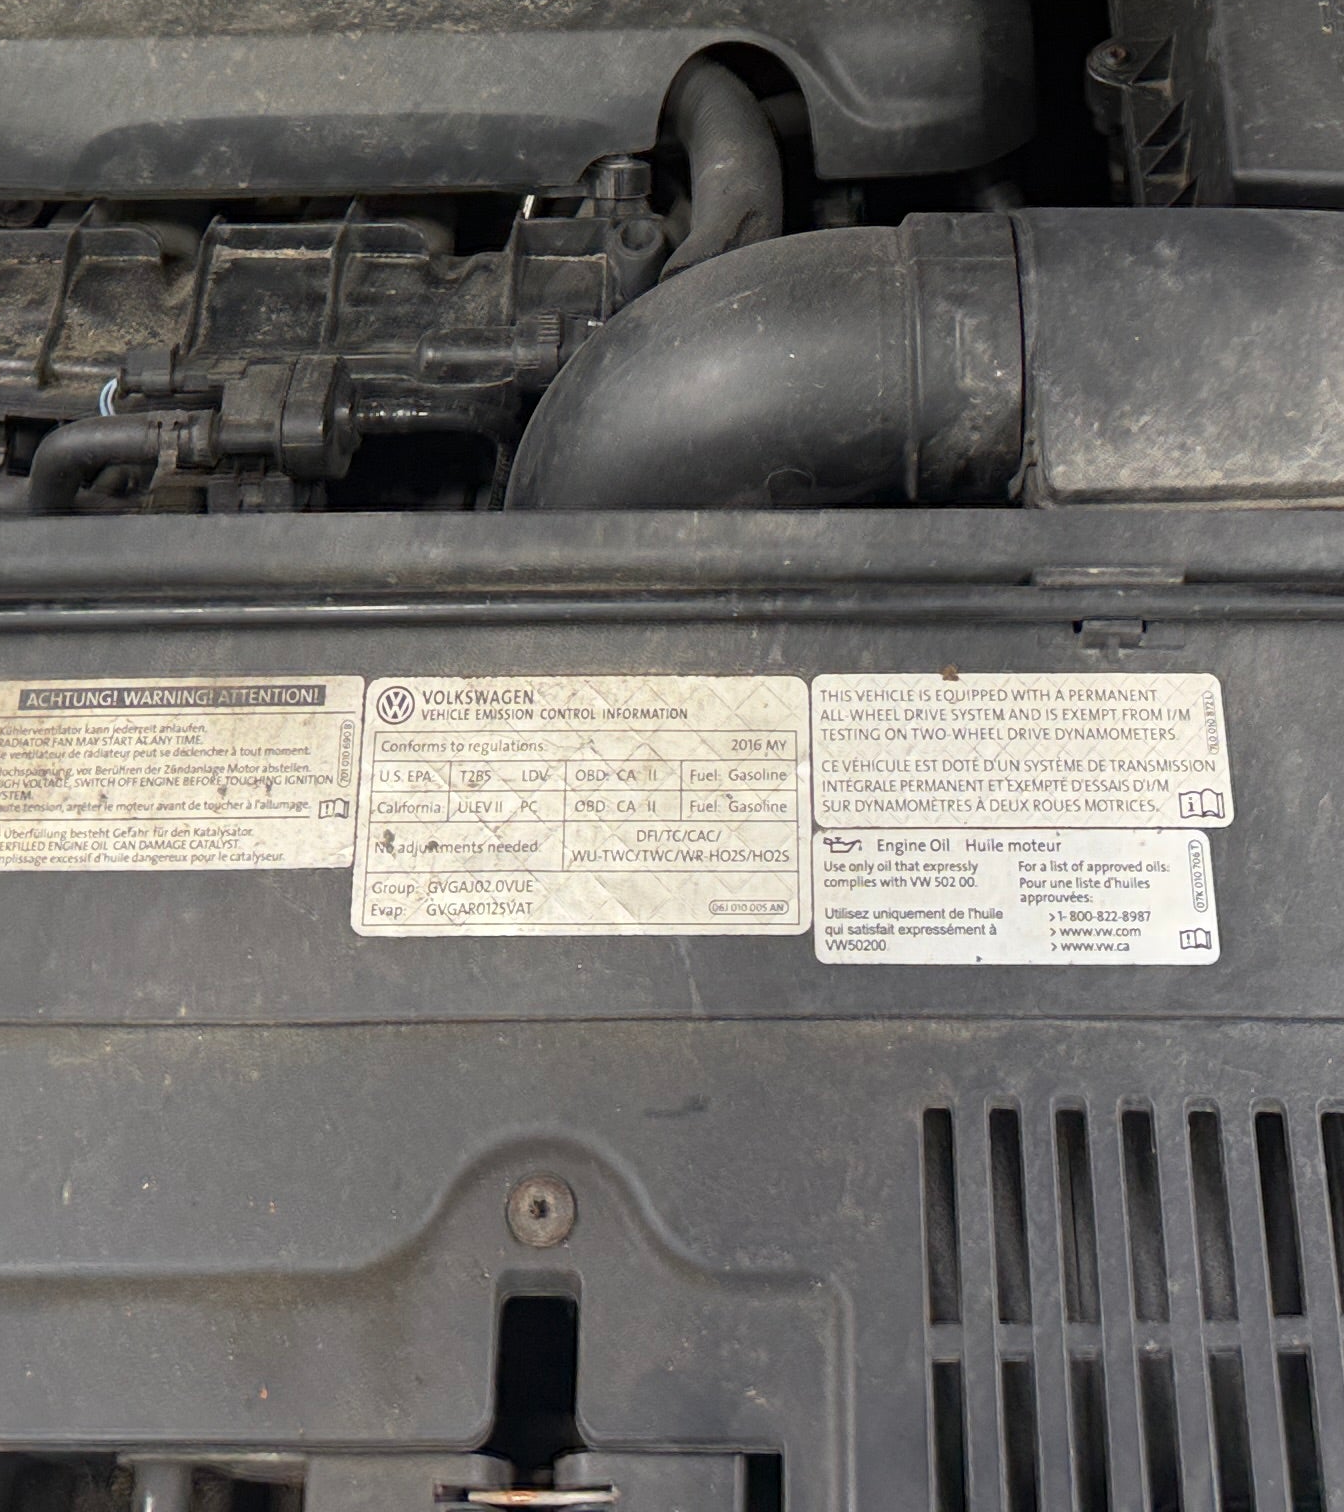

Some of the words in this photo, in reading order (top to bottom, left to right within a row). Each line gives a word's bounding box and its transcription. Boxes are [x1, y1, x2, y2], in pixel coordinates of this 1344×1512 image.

[26, 691, 117, 707] ACHTUNG!
[123, 689, 213, 706] WARNING!
[218, 687, 320, 704] ATTENTION!
[422, 690, 534, 705] VOLKSWAGEN
[820, 690, 852, 702] THIS
[856, 690, 914, 702] VEHICLE
[919, 690, 931, 702] IS
[935, 689, 1007, 704] EQUIPPED
[1011, 689, 1050, 701] WITH
[1056, 689, 1065, 701] A
[1069, 689, 1157, 702] PERMANENT
[421, 708, 470, 721] VEHICLE
[475, 708, 534, 720] EMISSION
[540, 708, 596, 720] CONTROL
[602, 708, 688, 719] INFORMATION
[820, 709, 900, 721] ALL-WHEEL
[904, 709, 947, 721] DRIVE
[951, 708, 1005, 721] SYSTEM
[1008, 708, 1041, 721] AND
[1046, 709, 1058, 721] IS
[1063, 708, 1117, 721] EXEMPT
[1122, 708, 1162, 721] FROM
[1167, 708, 1191, 721] I/M
[820, 728, 881, 740] TESTING
[885, 728, 907, 740] ON
[911, 728, 1003, 740] TWO-WHEEL
[1007, 728, 1051, 740] DRIVE
[381, 740, 446, 753] Conforms
[450, 741, 464, 752] to
[731, 739, 762, 751] 2016
[766, 739, 787, 751] MY
[821, 760, 838, 772] CE
[915, 760, 938, 772] EST
[942, 756, 979, 772] DOTÉ
[1088, 760, 1106, 772] DE
[1109, 759, 1216, 772] TRANSMISSION
[617, 770, 636, 781] CA
[728, 769, 787, 781] Gasoline
[900, 780, 984, 792] PERMANENT
[988, 780, 1002, 792] ET
[457, 802, 492, 813] ULEV
[495, 802, 503, 813] II
[520, 801, 538, 813] PC
[617, 801, 636, 812] CA
[648, 801, 656, 812] II
[728, 800, 787, 813] Gasoline
[823, 800, 851, 812] SUR
[975, 796, 986, 812] À
[990, 799, 1029, 812] DEUX
[1033, 799, 1081, 812] ROUES
[1085, 799, 1161, 812] MOTRICES.
[636, 829, 723, 843] DFI/TC/CAC/
[48, 841, 88, 852] ENGINE
[91, 840, 108, 852] OIL
[113, 840, 136, 851] CAN
[139, 839, 186, 851] DAMAGE
[877, 839, 926, 856] Engine
[930, 839, 950, 852] Oil
[966, 839, 1003, 852] Huile
[1008, 839, 1061, 852] moteur
[824, 861, 846, 872] Use
[849, 861, 874, 875] only
[877, 860, 892, 871] oil
[894, 861, 920, 872] that
[923, 861, 978, 875] expressly
[1018, 861, 1036, 872] For
[1040, 864, 1047, 872] a
[1050, 861, 1068, 872] list
[1071, 861, 1084, 872] of
[1087, 861, 1142, 875] approved
[1146, 861, 1170, 872] oils:
[824, 877, 877, 890] complies
[881, 877, 907, 888] with
[910, 877, 931, 887] VW
[935, 876, 955, 887] 502
[959, 876, 978, 887] 00.
[1019, 878, 1047, 888] Pour
[1050, 879, 1073, 888] une
[1075, 877, 1100, 888] liste
[1103, 877, 1150, 888] d'huiles
[1194, 872, 1203, 887] 010
[1020, 892, 1093, 905] approuvées:
[770, 903, 784, 913] AN
[824, 908, 869, 920] Utilisez
[873, 908, 945, 923] uniquement
[949, 908, 964, 919] de
[968, 908, 1003, 919] l'huile
[825, 924, 843, 937] qui
[848, 923, 895, 935] satisfait
[898, 923, 986, 937] expressément
[989, 923, 997, 936] à
[1059, 928, 1141, 937] www.vw.com
[1060, 943, 1130, 952] www.vw.ca
